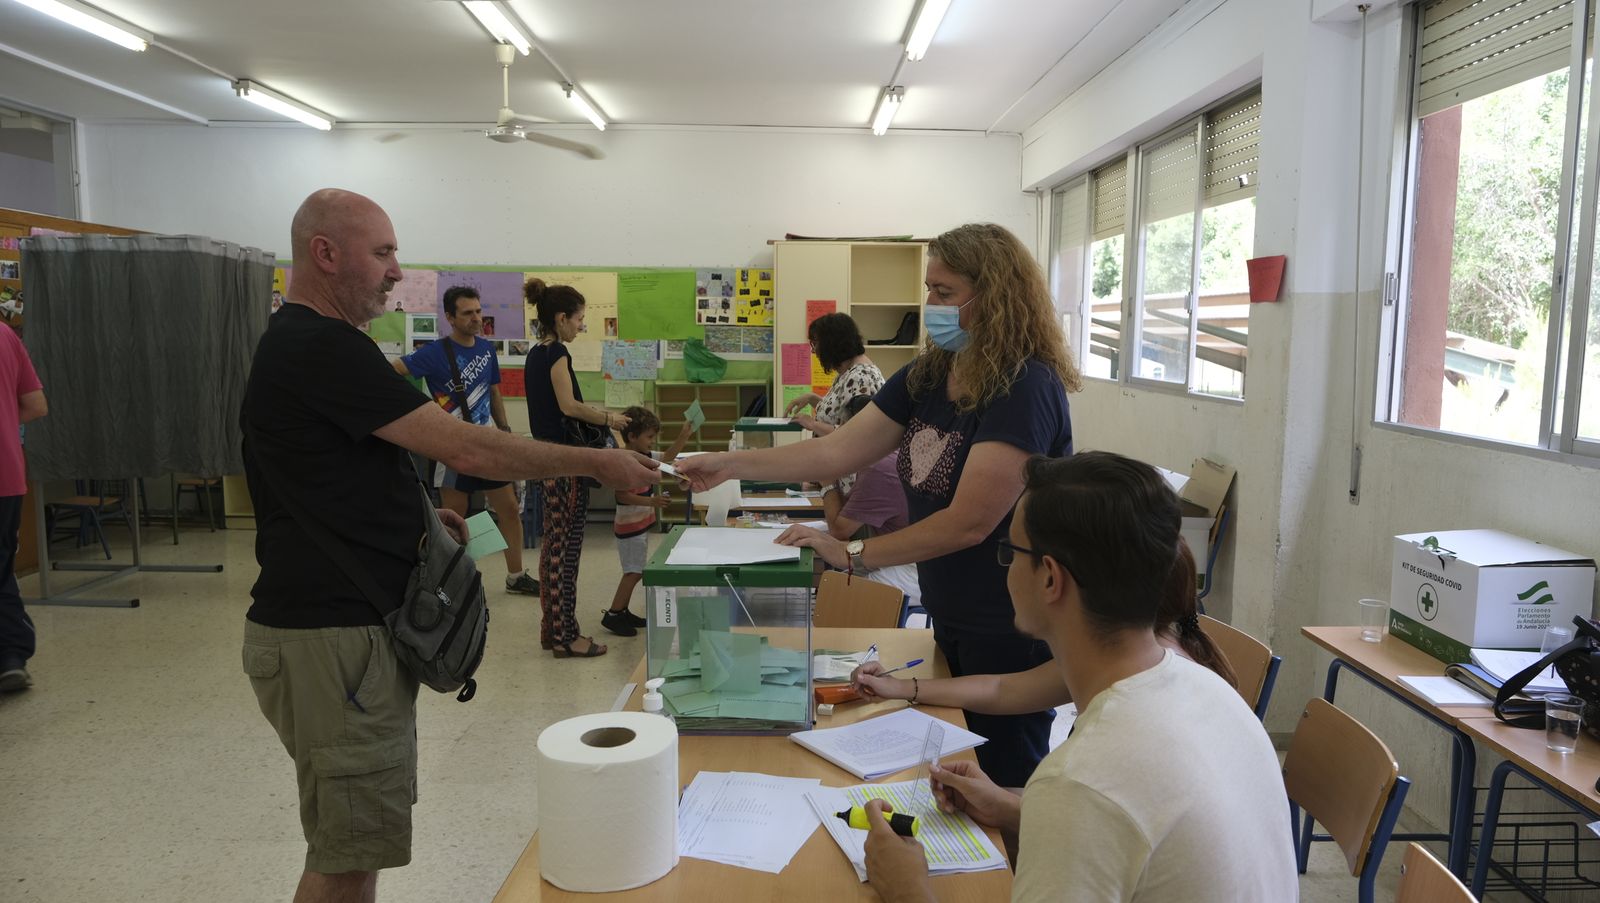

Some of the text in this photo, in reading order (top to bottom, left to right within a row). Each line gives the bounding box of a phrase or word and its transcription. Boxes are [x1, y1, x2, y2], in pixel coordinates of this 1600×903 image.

[463, 350, 491, 390] ARATON
[1402, 561, 1462, 590] KIT DE SEGURIDAD COVID
